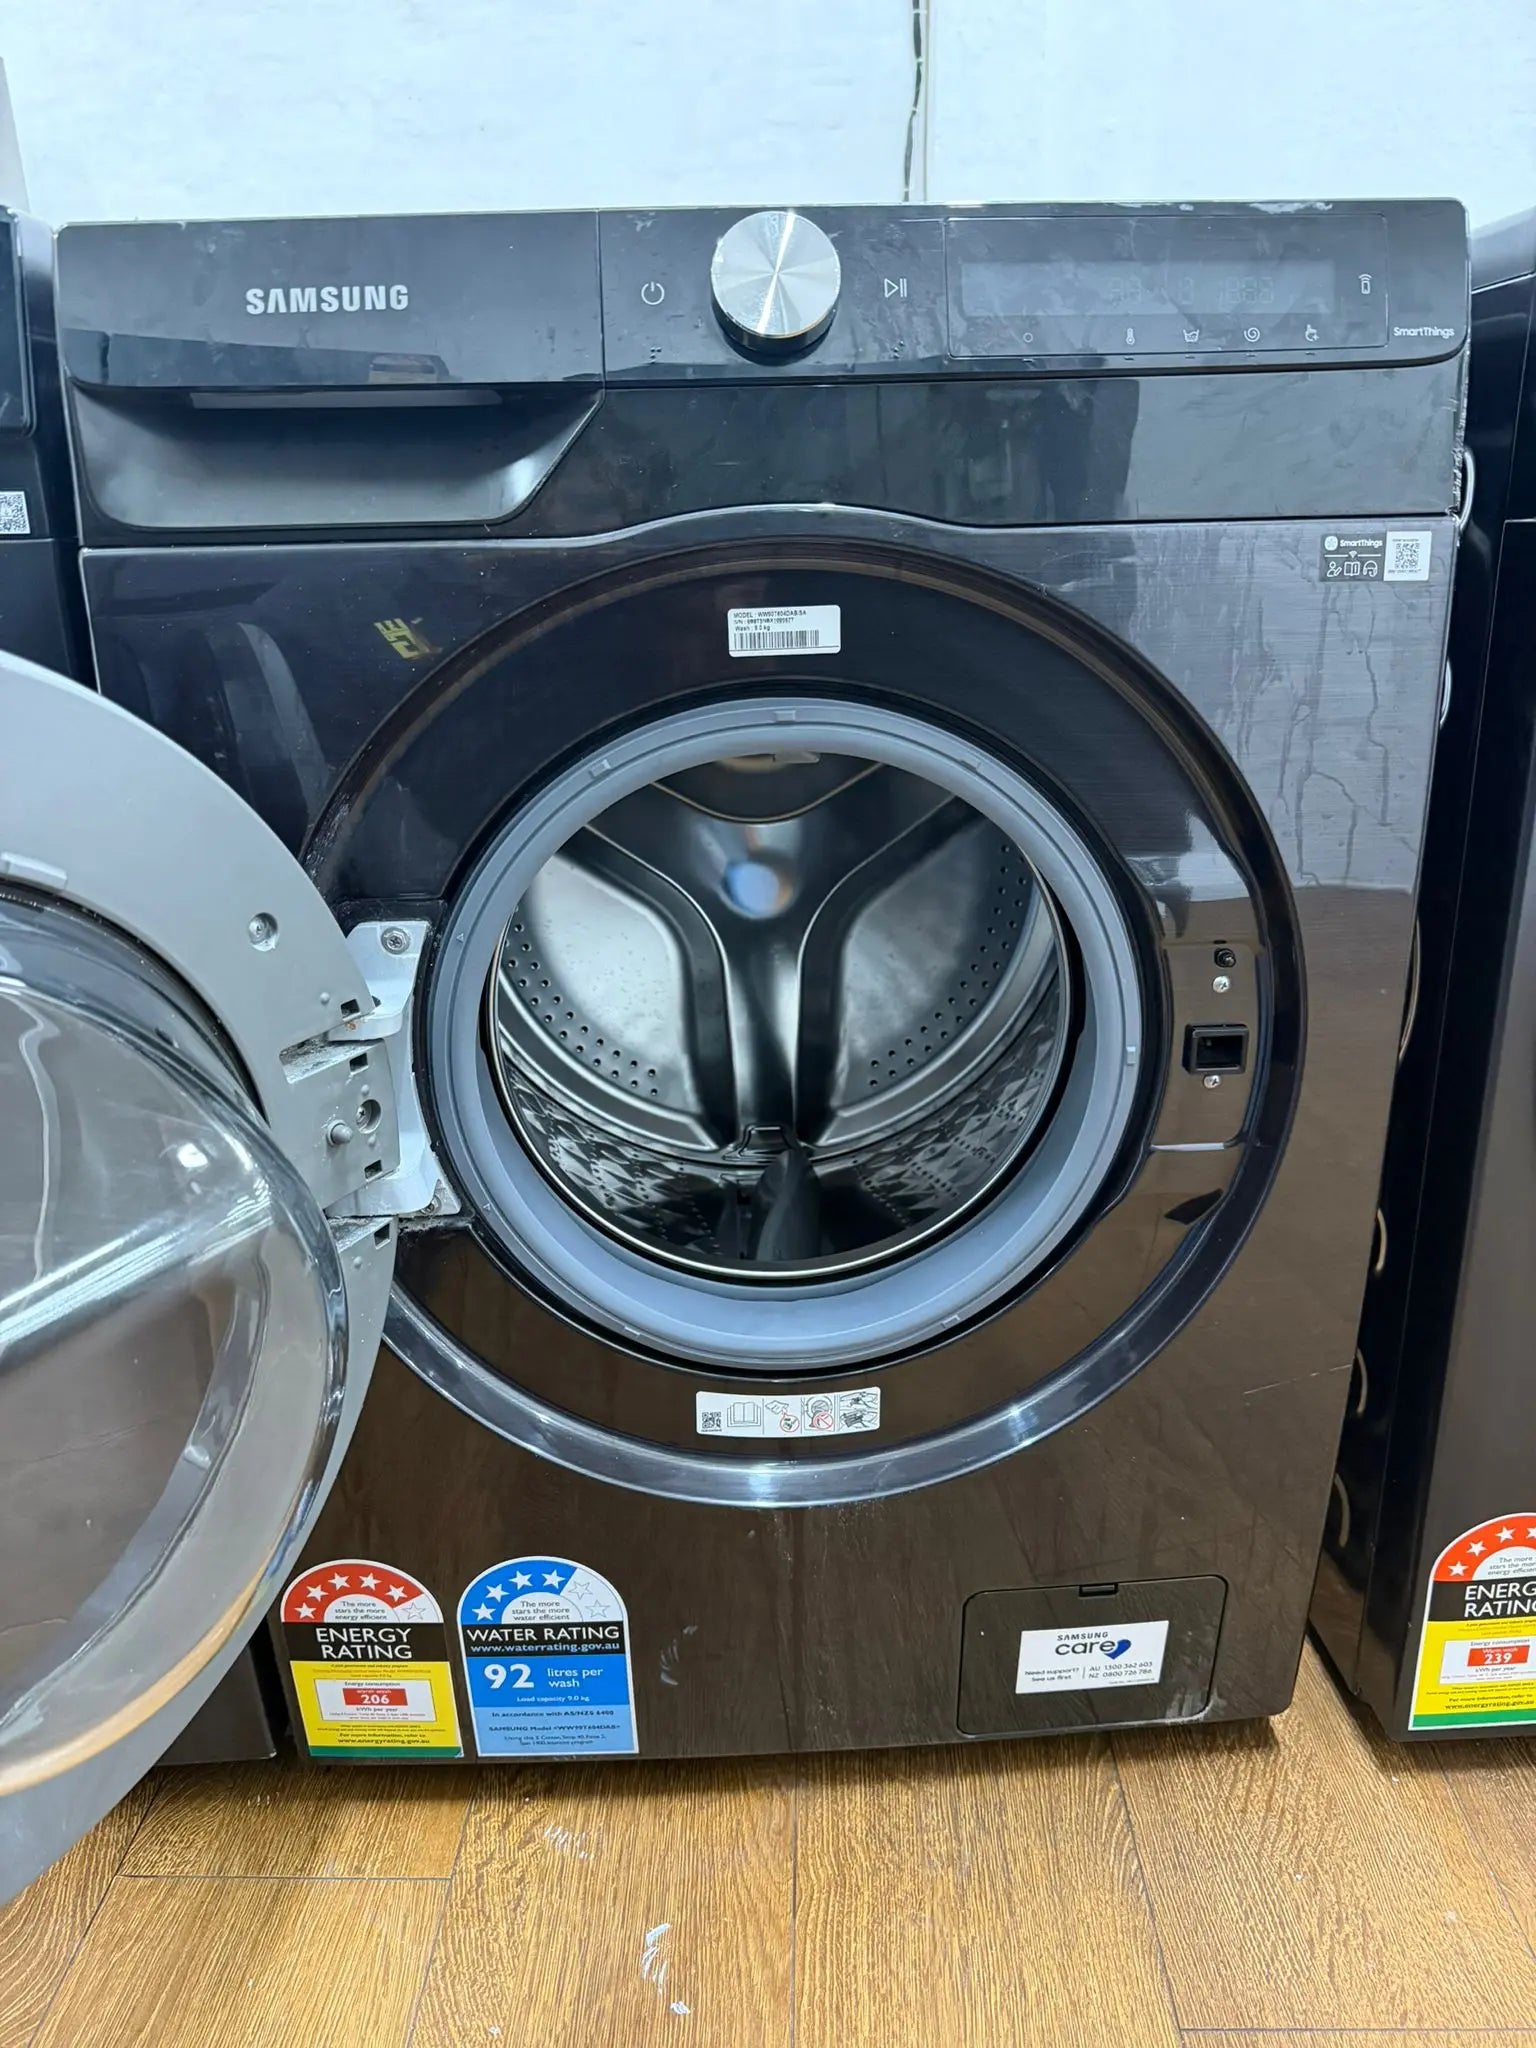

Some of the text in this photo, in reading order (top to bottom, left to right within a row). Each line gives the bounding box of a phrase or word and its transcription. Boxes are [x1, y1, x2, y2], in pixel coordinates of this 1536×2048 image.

[246, 285, 409, 315] SAMSUNG
[1393, 326, 1455, 339] SmartThings
[1340, 539, 1383, 549] SmartThings
[1499, 1556, 1512, 1564] The
[1464, 1580, 1536, 1601] ENERG
[342, 1600, 355, 1608] The
[521, 1600, 536, 1608] The
[538, 1613, 570, 1621] efficient
[316, 1627, 412, 1643] ENERGY
[466, 1625, 620, 1642] WATER RATING
[1057, 1631, 1109, 1642] SAMSUNG
[321, 1644, 413, 1659] RATING
[470, 1641, 620, 1653] www.waterrating.gov.au
[1055, 1640, 1116, 1656] care
[1484, 1652, 1513, 1665] 239
[483, 1663, 604, 1690] 92 litres per
[548, 1678, 580, 1688] wash
[360, 1694, 390, 1705] 206
